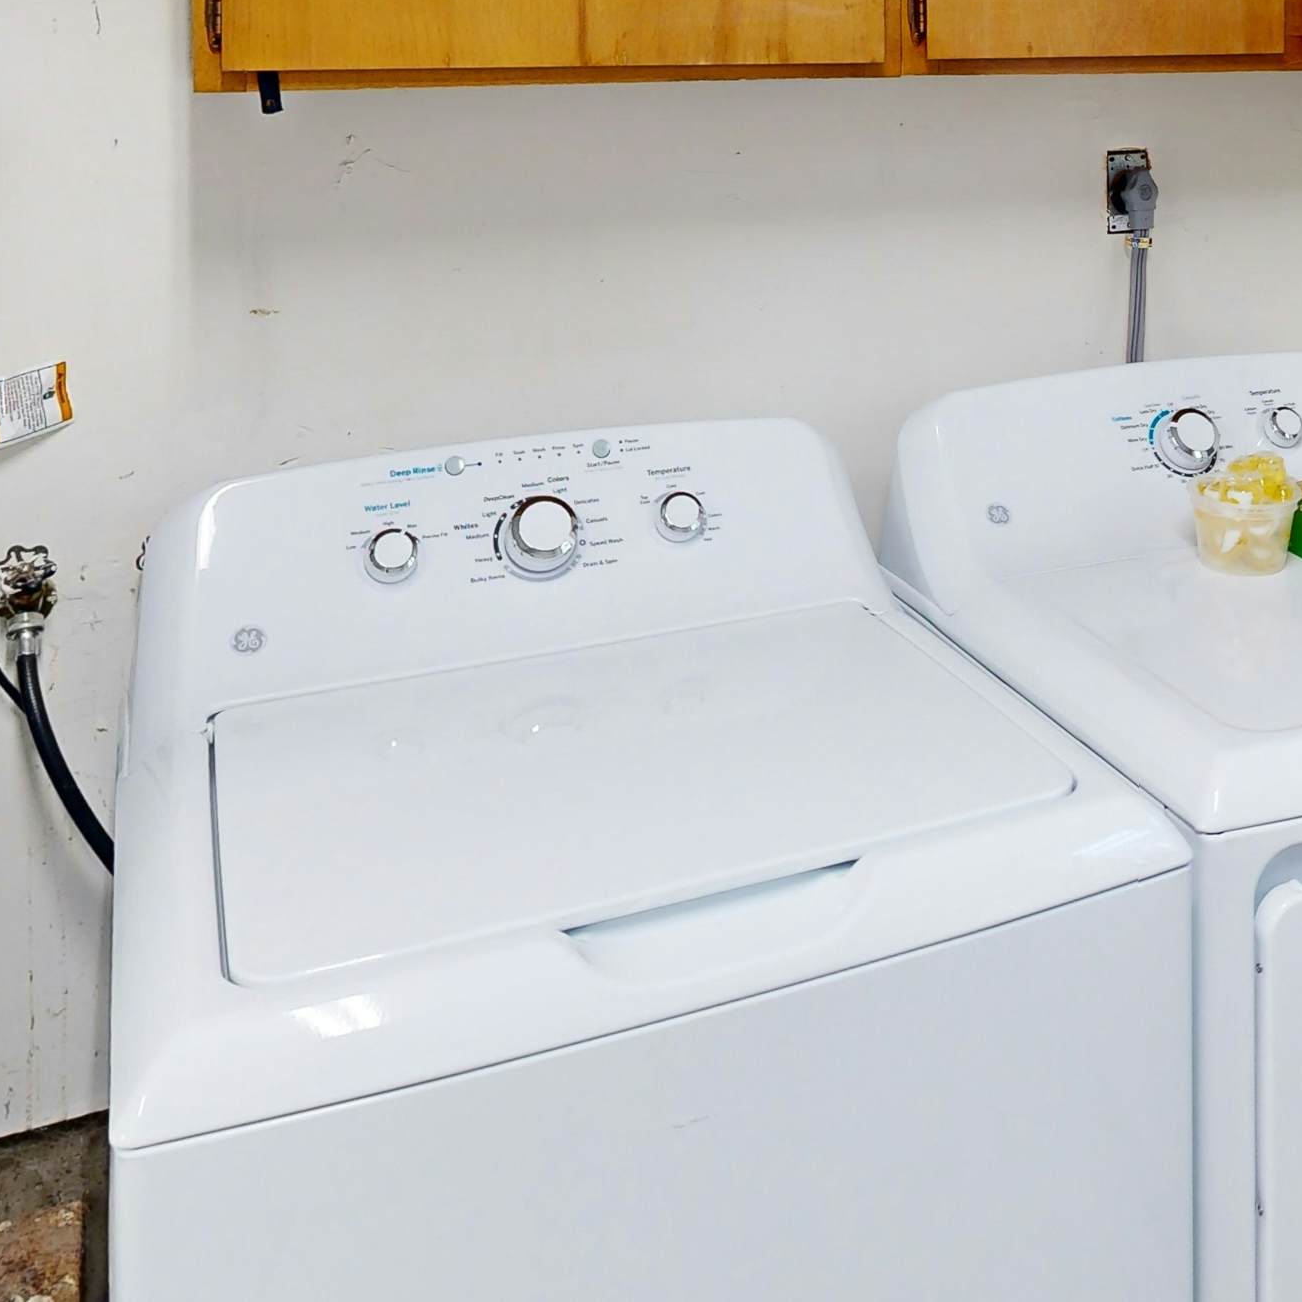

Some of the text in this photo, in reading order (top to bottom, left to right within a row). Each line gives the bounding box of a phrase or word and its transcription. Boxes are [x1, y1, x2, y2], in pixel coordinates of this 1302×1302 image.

[647, 466, 690, 476] Temperature
[547, 475, 569, 483] Colors
[365, 501, 410, 512] Water Level
[454, 523, 478, 531] Whites
